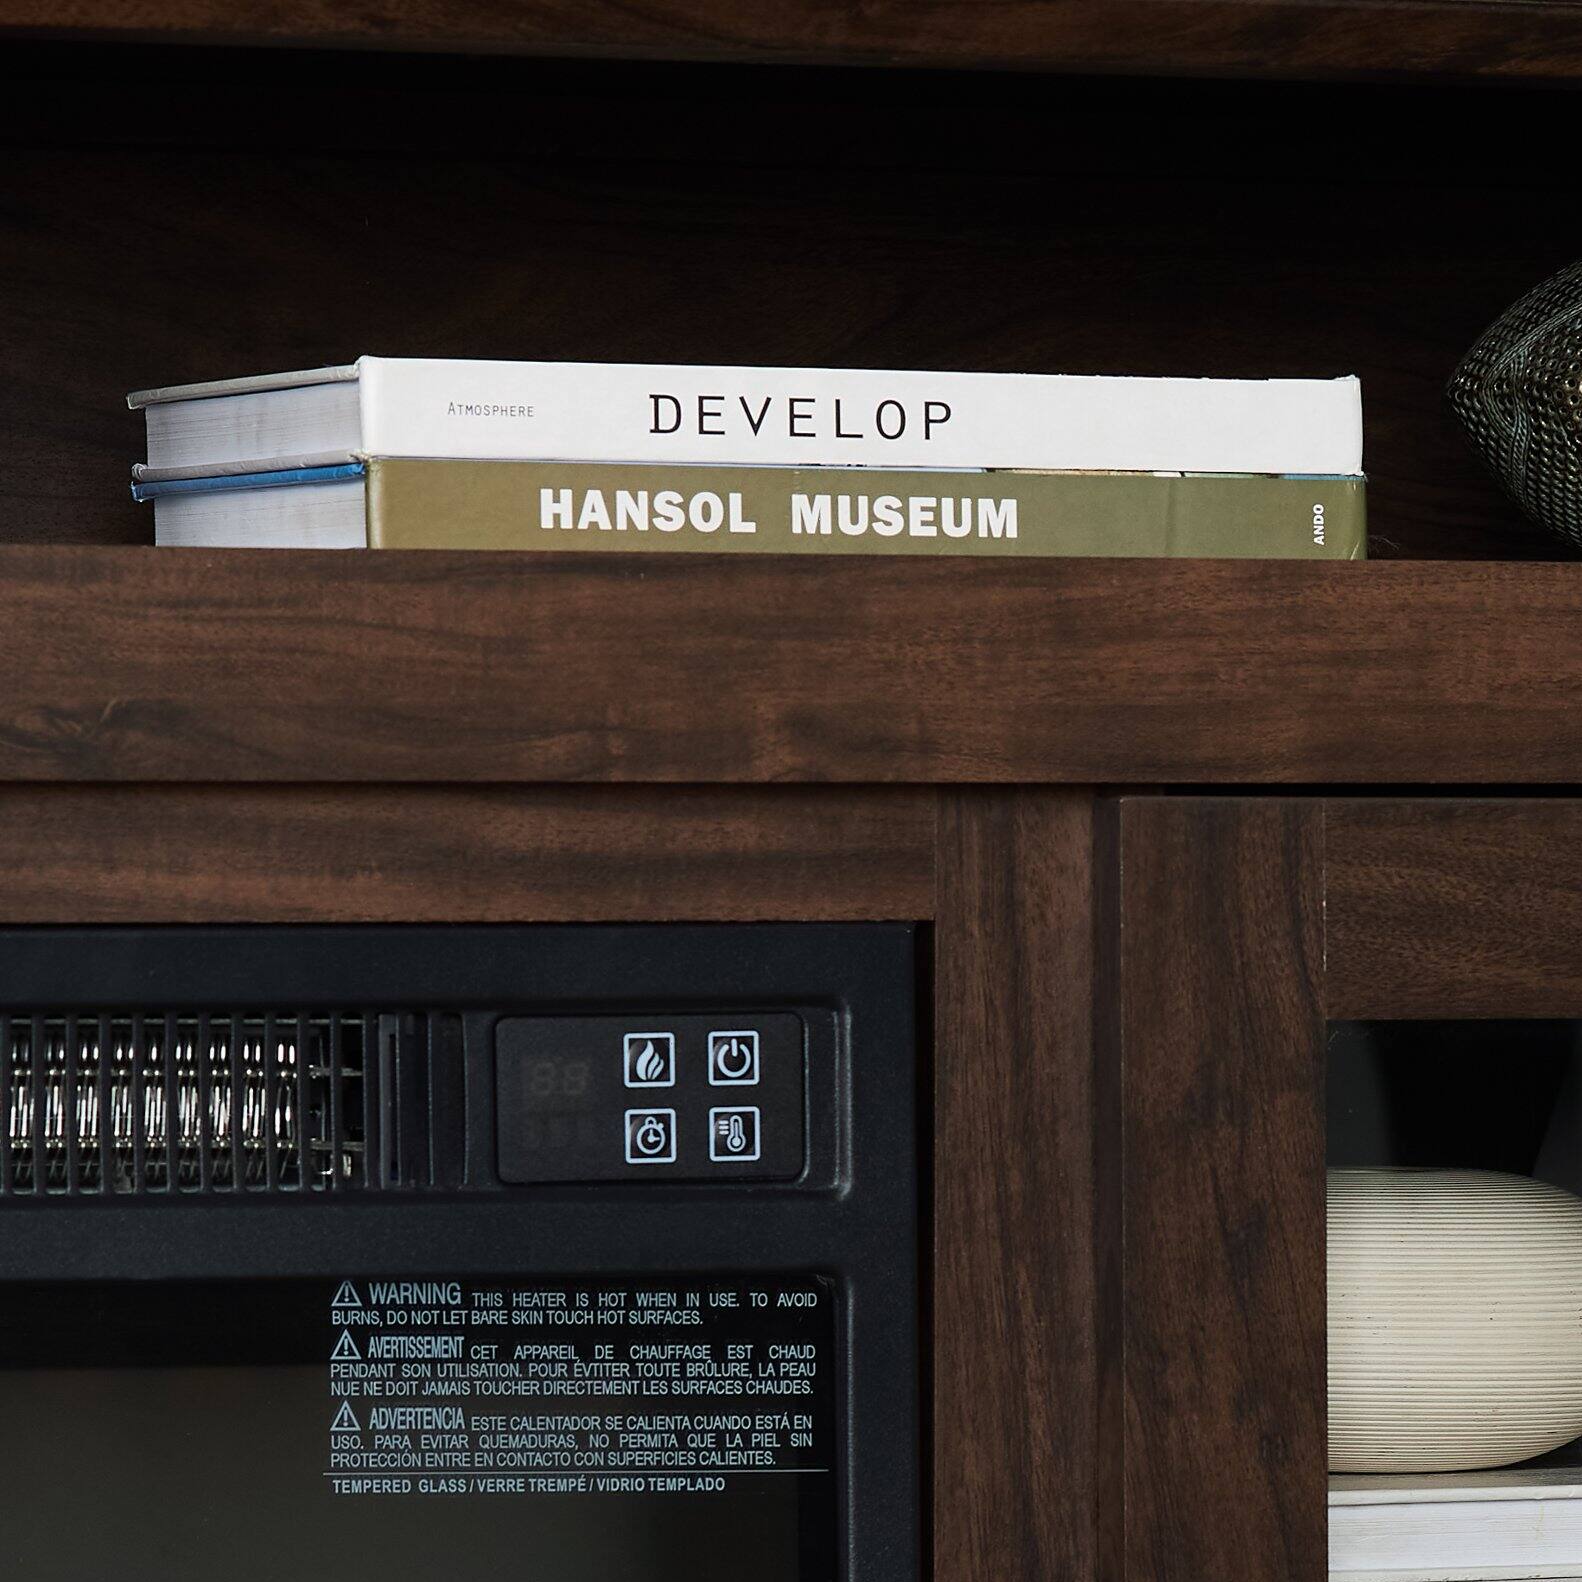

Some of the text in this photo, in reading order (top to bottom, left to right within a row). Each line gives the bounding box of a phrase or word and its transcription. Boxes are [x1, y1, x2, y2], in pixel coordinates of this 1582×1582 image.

[649, 393, 952, 441] DEVELOP
[540, 488, 1018, 539] HANSOL MUSEUM
[1313, 503, 1325, 546] ANDO
[369, 1283, 817, 1306] WARNING THIS HEATER IS HOT WHEN IN USE. TO AVOID
[333, 1311, 703, 1327] BURNS, DO NOT LET BARE SKIN TOUCH HOT SURFACES.
[368, 1337, 815, 1359] AVERTISSEMENT CET APPAREIL DE CHAUFFAGE EST CHAUD
[331, 1364, 396, 1377] PENDANT
[402, 1364, 431, 1377] SON
[437, 1364, 522, 1377] UTILISATION.
[529, 1364, 567, 1377] POUR
[636, 1363, 680, 1377] TOUTE
[687, 1360, 752, 1379] BRÛLURE,
[759, 1363, 775, 1376] LA
[780, 1363, 816, 1376] PEAU
[331, 1381, 813, 1396] NUE NE DOIT JAMAIS TOUCHER DIRECTEMENT LES SURFACES CHAUDES.
[369, 1408, 812, 1430] ADVERTENCIA ESTE CALENTADOR SE CALIENTA CUANDO ESTÁ EN
[331, 1433, 812, 1450] USO. PARA EVITAR QUEMADURAS, NO PERMITA QUE LA PIEL SIN
[331, 1449, 775, 1467] PROTECCIÓN ENTRE EN CONTACTO CON SUPERFICIES CALIENTES.
[333, 1480, 411, 1493] TEMPERED
[419, 1479, 466, 1493] GLASS
[478, 1479, 524, 1492] VERRE
[528, 1475, 586, 1492] TREMPÉ
[597, 1478, 645, 1491] VIDRIO
[648, 1477, 725, 1490] TEMPLADO
